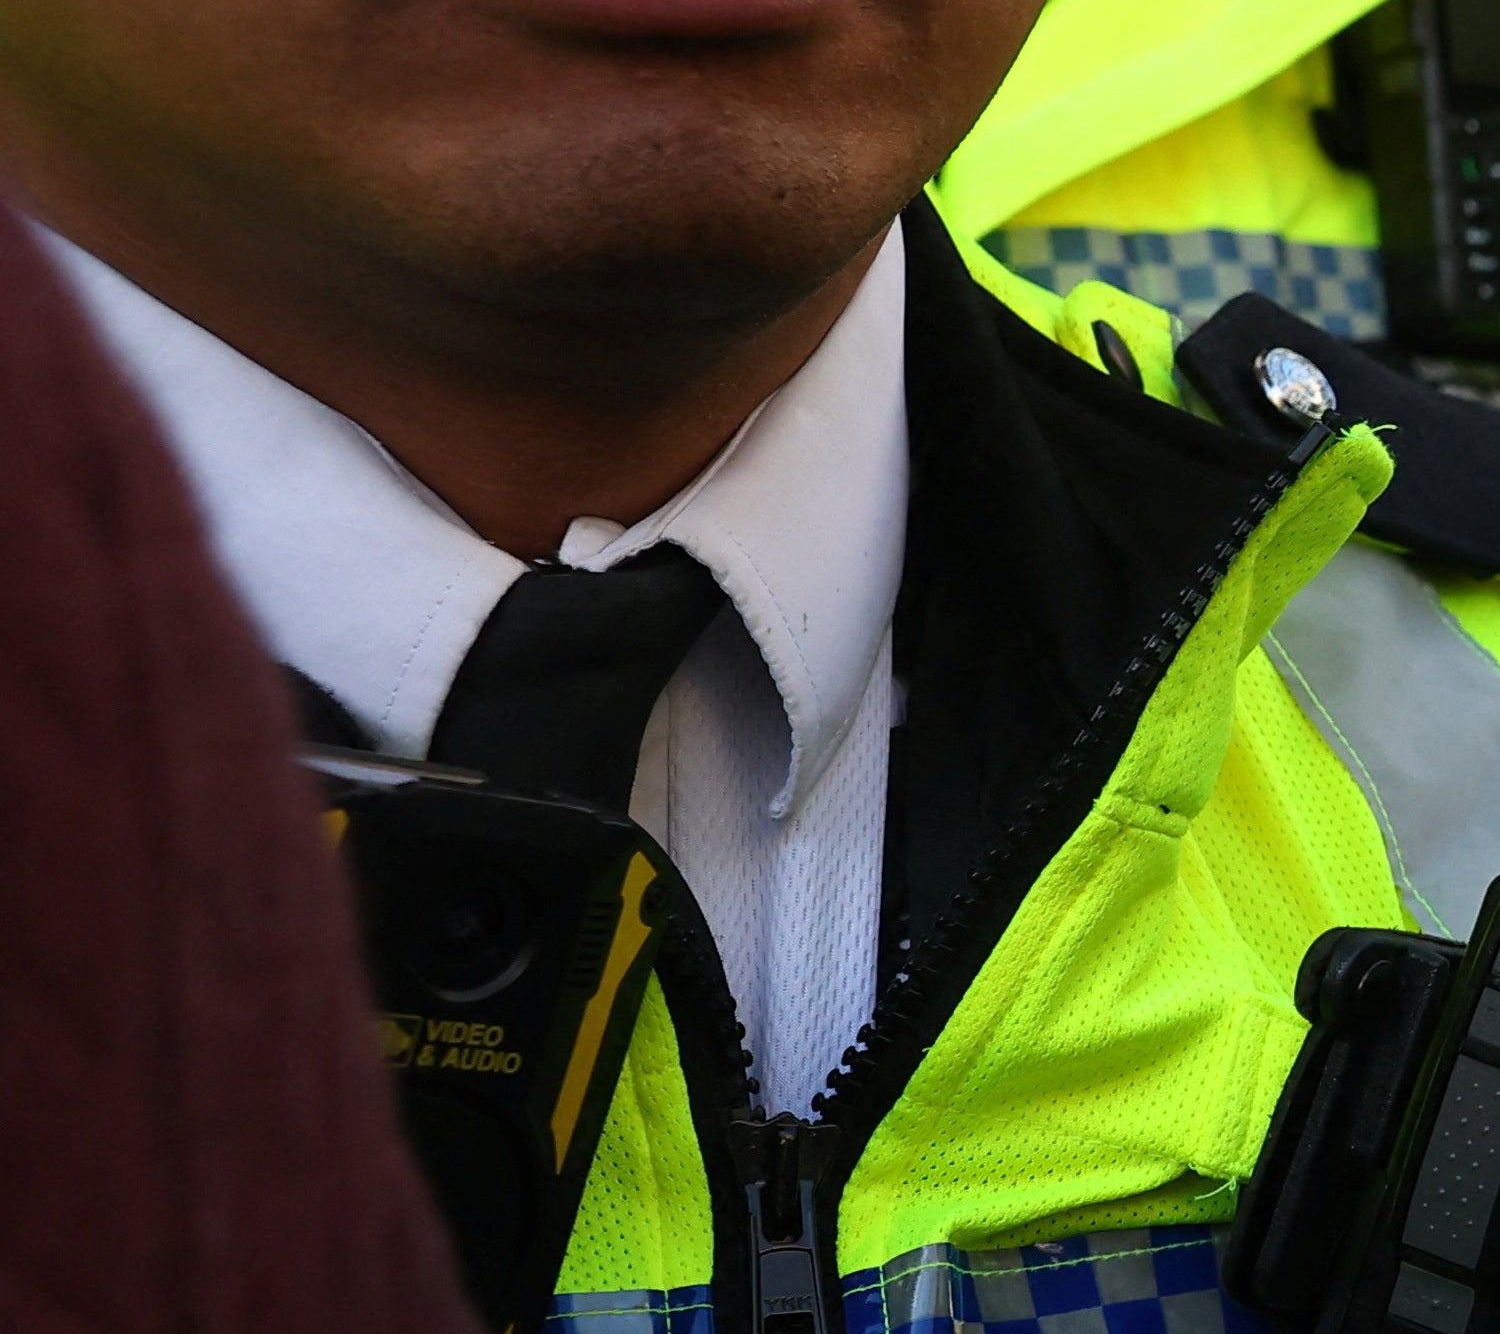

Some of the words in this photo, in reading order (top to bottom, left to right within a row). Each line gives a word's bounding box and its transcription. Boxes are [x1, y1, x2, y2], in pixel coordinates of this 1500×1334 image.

[427, 1020, 504, 1047] VIDEO
[417, 1044, 435, 1066] &
[441, 1047, 522, 1074] AUDIO
